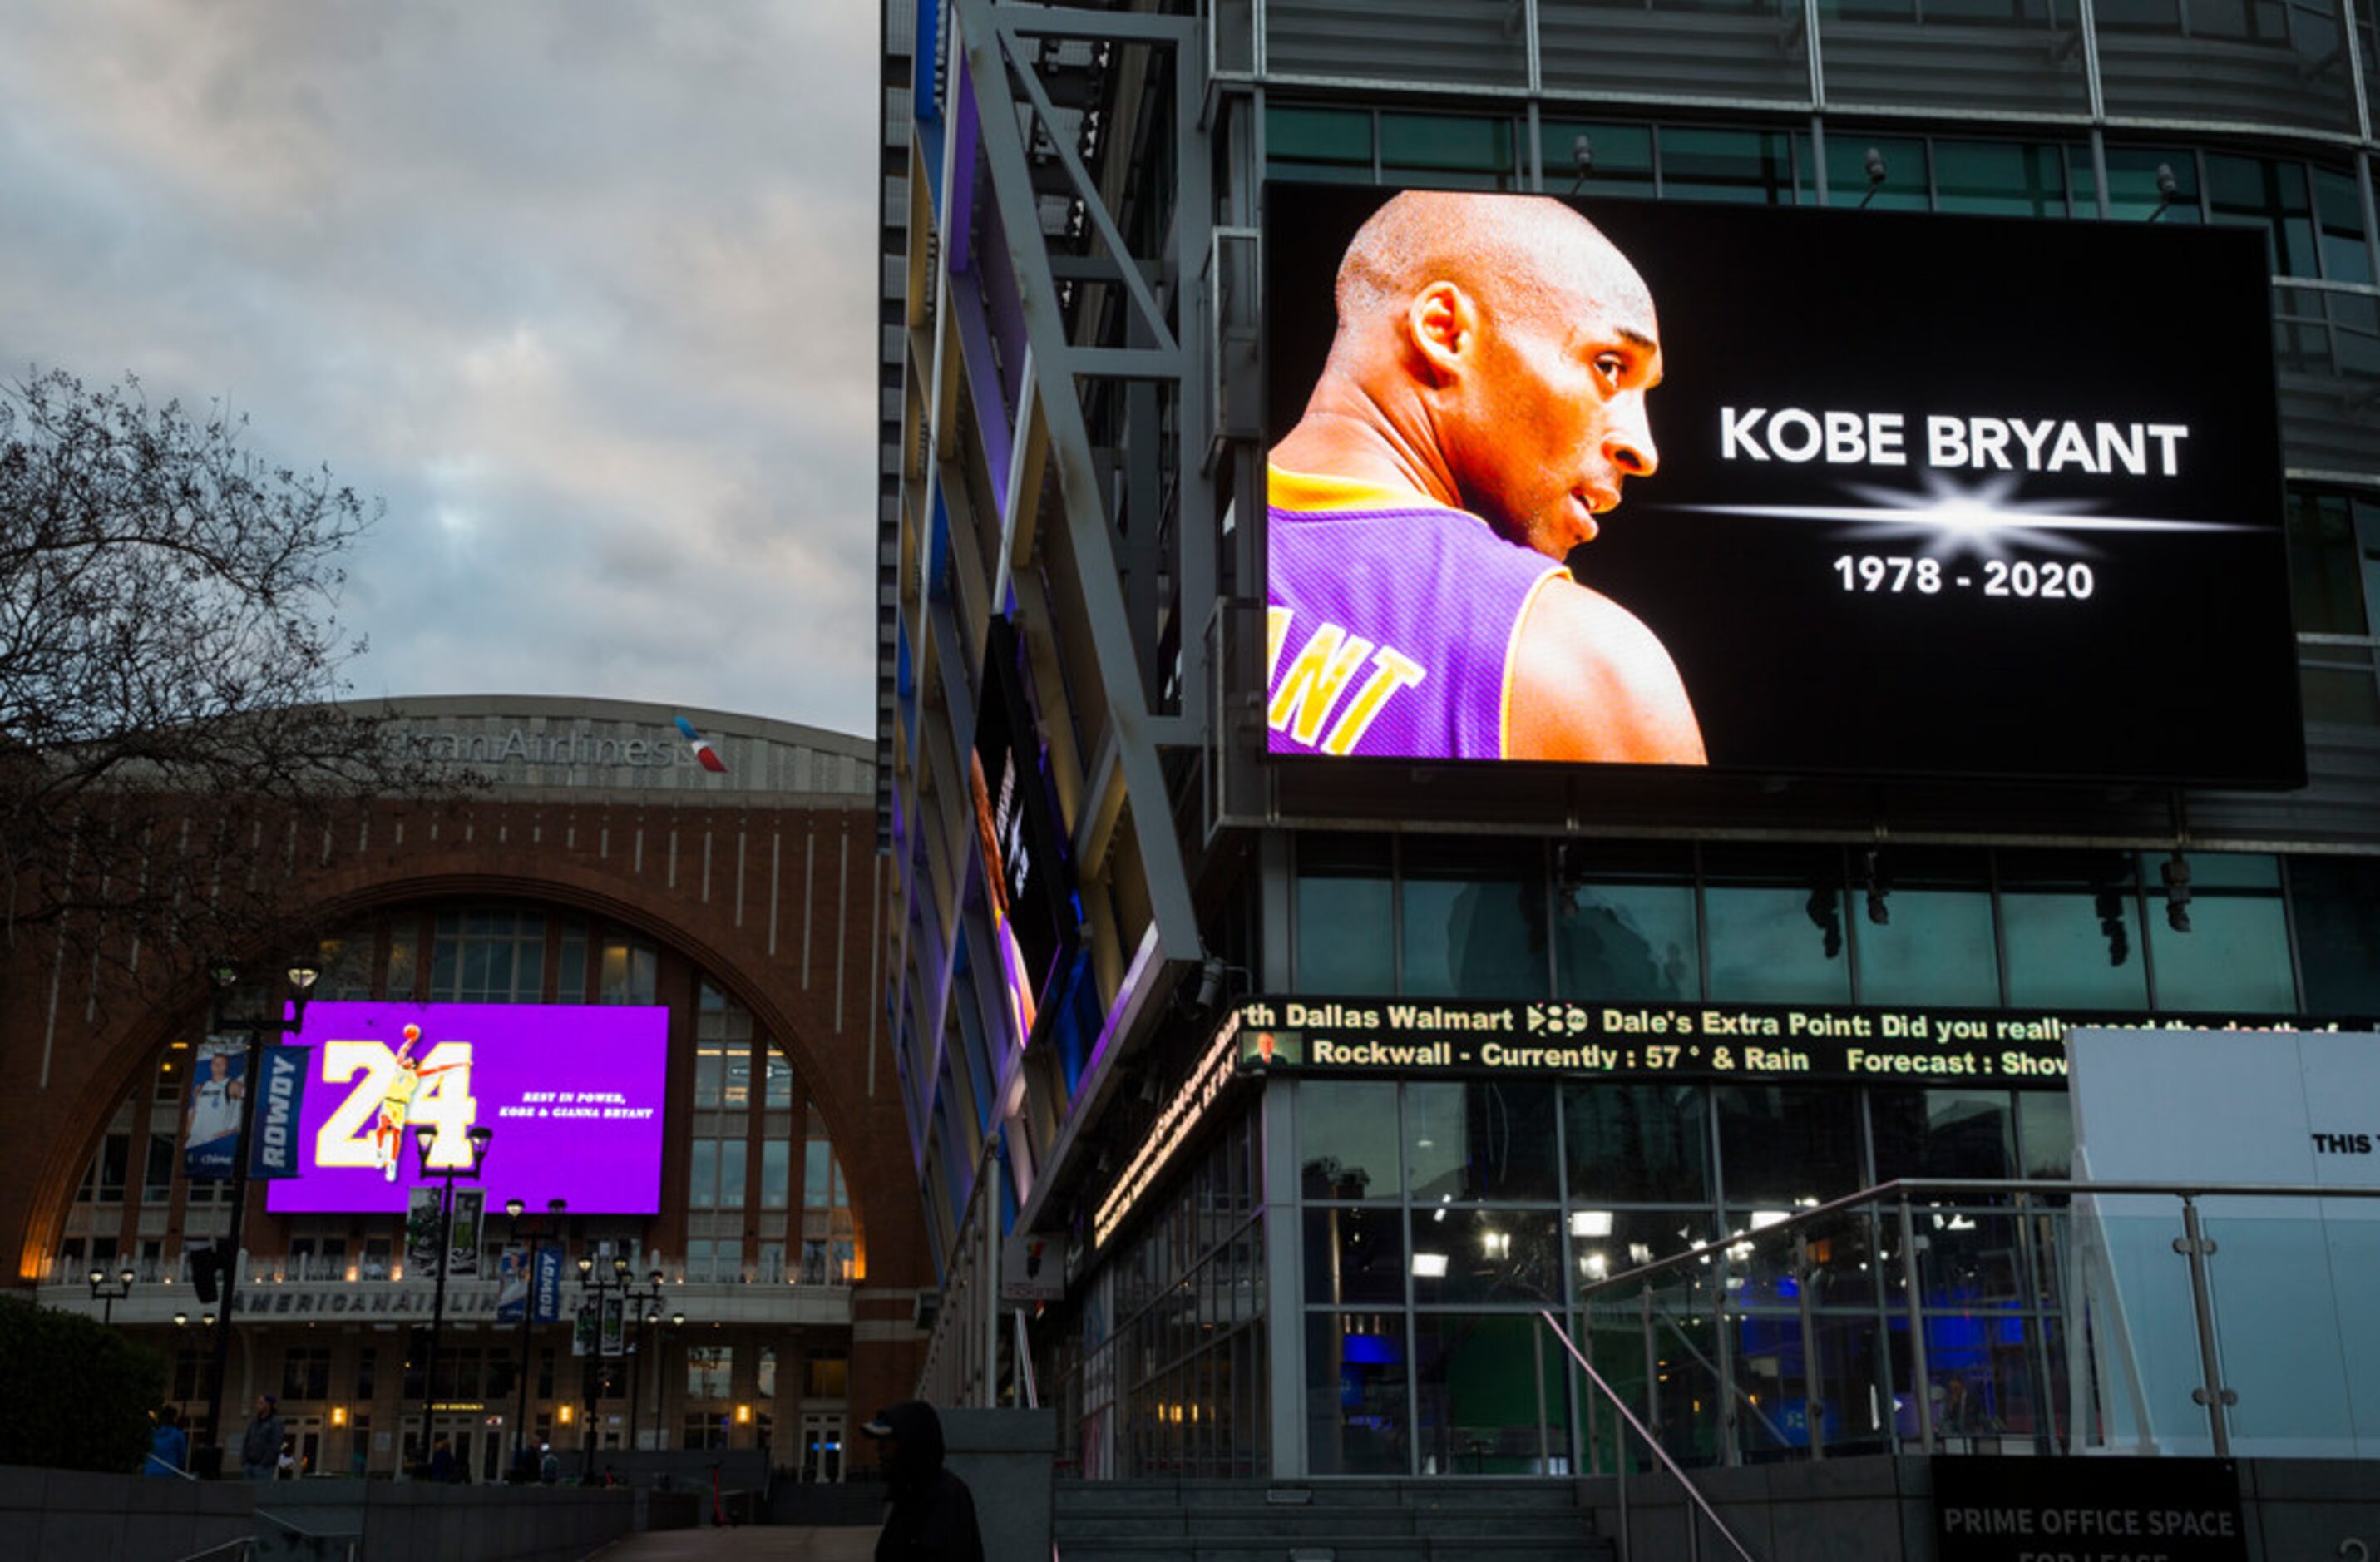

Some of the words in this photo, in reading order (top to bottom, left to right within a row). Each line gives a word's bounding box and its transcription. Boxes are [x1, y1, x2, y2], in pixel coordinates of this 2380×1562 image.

[1720, 406, 1907, 466] KOBE
[1926, 414, 2189, 476] BRYANT
[1834, 555, 1942, 594] 1978
[1956, 575, 1972, 587] -
[1983, 560, 2094, 599] 2020
[1241, 1004, 1276, 1027] th
[1286, 1003, 1380, 1028] Dallas
[1386, 1004, 1513, 1031] Walmart
[1602, 1008, 1693, 1033] Dale's
[1701, 1011, 1780, 1036] Extra
[1788, 1012, 1872, 1037] Point:
[1881, 1014, 1928, 1038] Did
[1935, 1019, 1988, 1044] you
[1313, 1040, 1451, 1065] Rockwall
[1481, 1042, 1618, 1070] Currently
[1646, 1045, 1681, 1069] 57
[1712, 1045, 1735, 1070] &
[1744, 1046, 1810, 1071] Rain
[1847, 1048, 1977, 1074] Forecast
[262, 1053, 296, 1168] ROWDY
[315, 1041, 477, 1169] 24
[499, 1106, 535, 1117] KOBE
[538, 1107, 548, 1117] &
[552, 1107, 600, 1118] GIANNA
[603, 1108, 654, 1119] BRYANT
[522, 1091, 557, 1103] REST
[559, 1092, 575, 1103] IN
[2311, 1134, 2372, 1154] THIS
[538, 1251, 556, 1317] ROWDY
[1943, 1507, 2034, 1535] PRIME
[2040, 1508, 2141, 1535] OFFICE
[2146, 1509, 2236, 1537] SPACE
